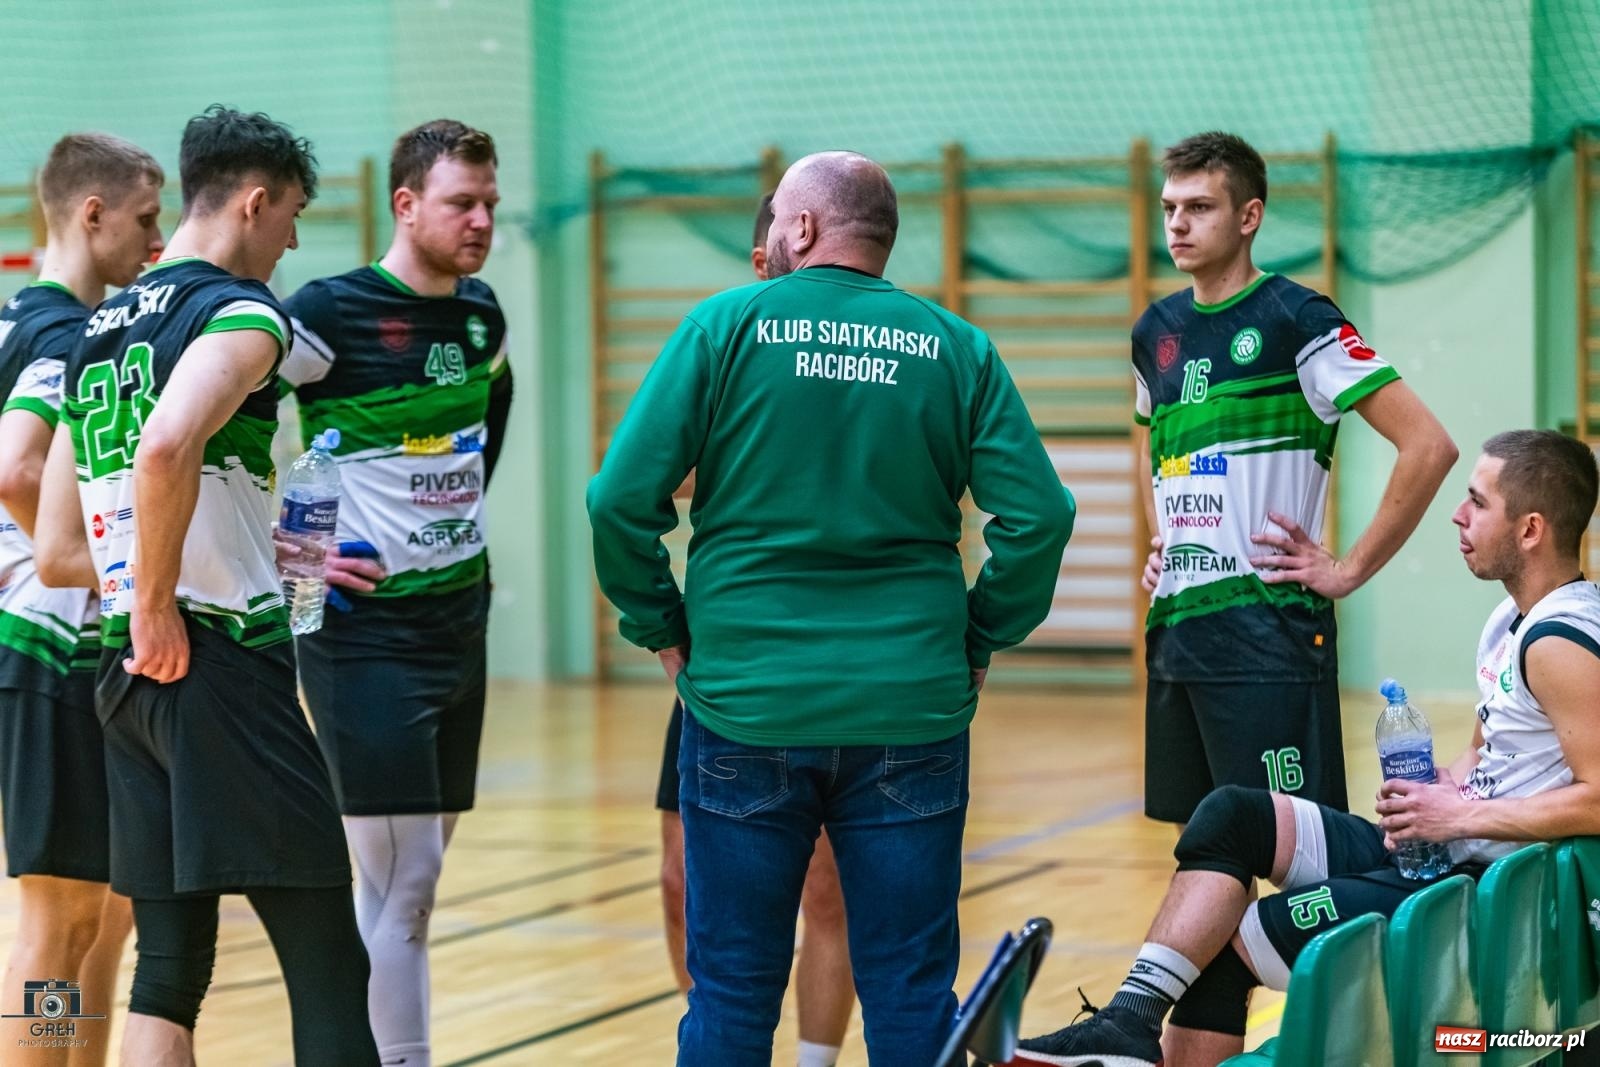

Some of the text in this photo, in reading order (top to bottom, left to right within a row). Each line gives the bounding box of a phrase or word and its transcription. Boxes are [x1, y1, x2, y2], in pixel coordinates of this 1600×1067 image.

[757, 319, 940, 360] KLUB SIATKARSKI
[424, 342, 467, 386] 49
[795, 352, 899, 385] RACIBÓRZ
[1181, 358, 1212, 404] 16
[78, 341, 160, 480] 23
[411, 471, 479, 492] PIVEXIN
[1261, 746, 1304, 792] 16
[1287, 885, 1340, 930] 15
